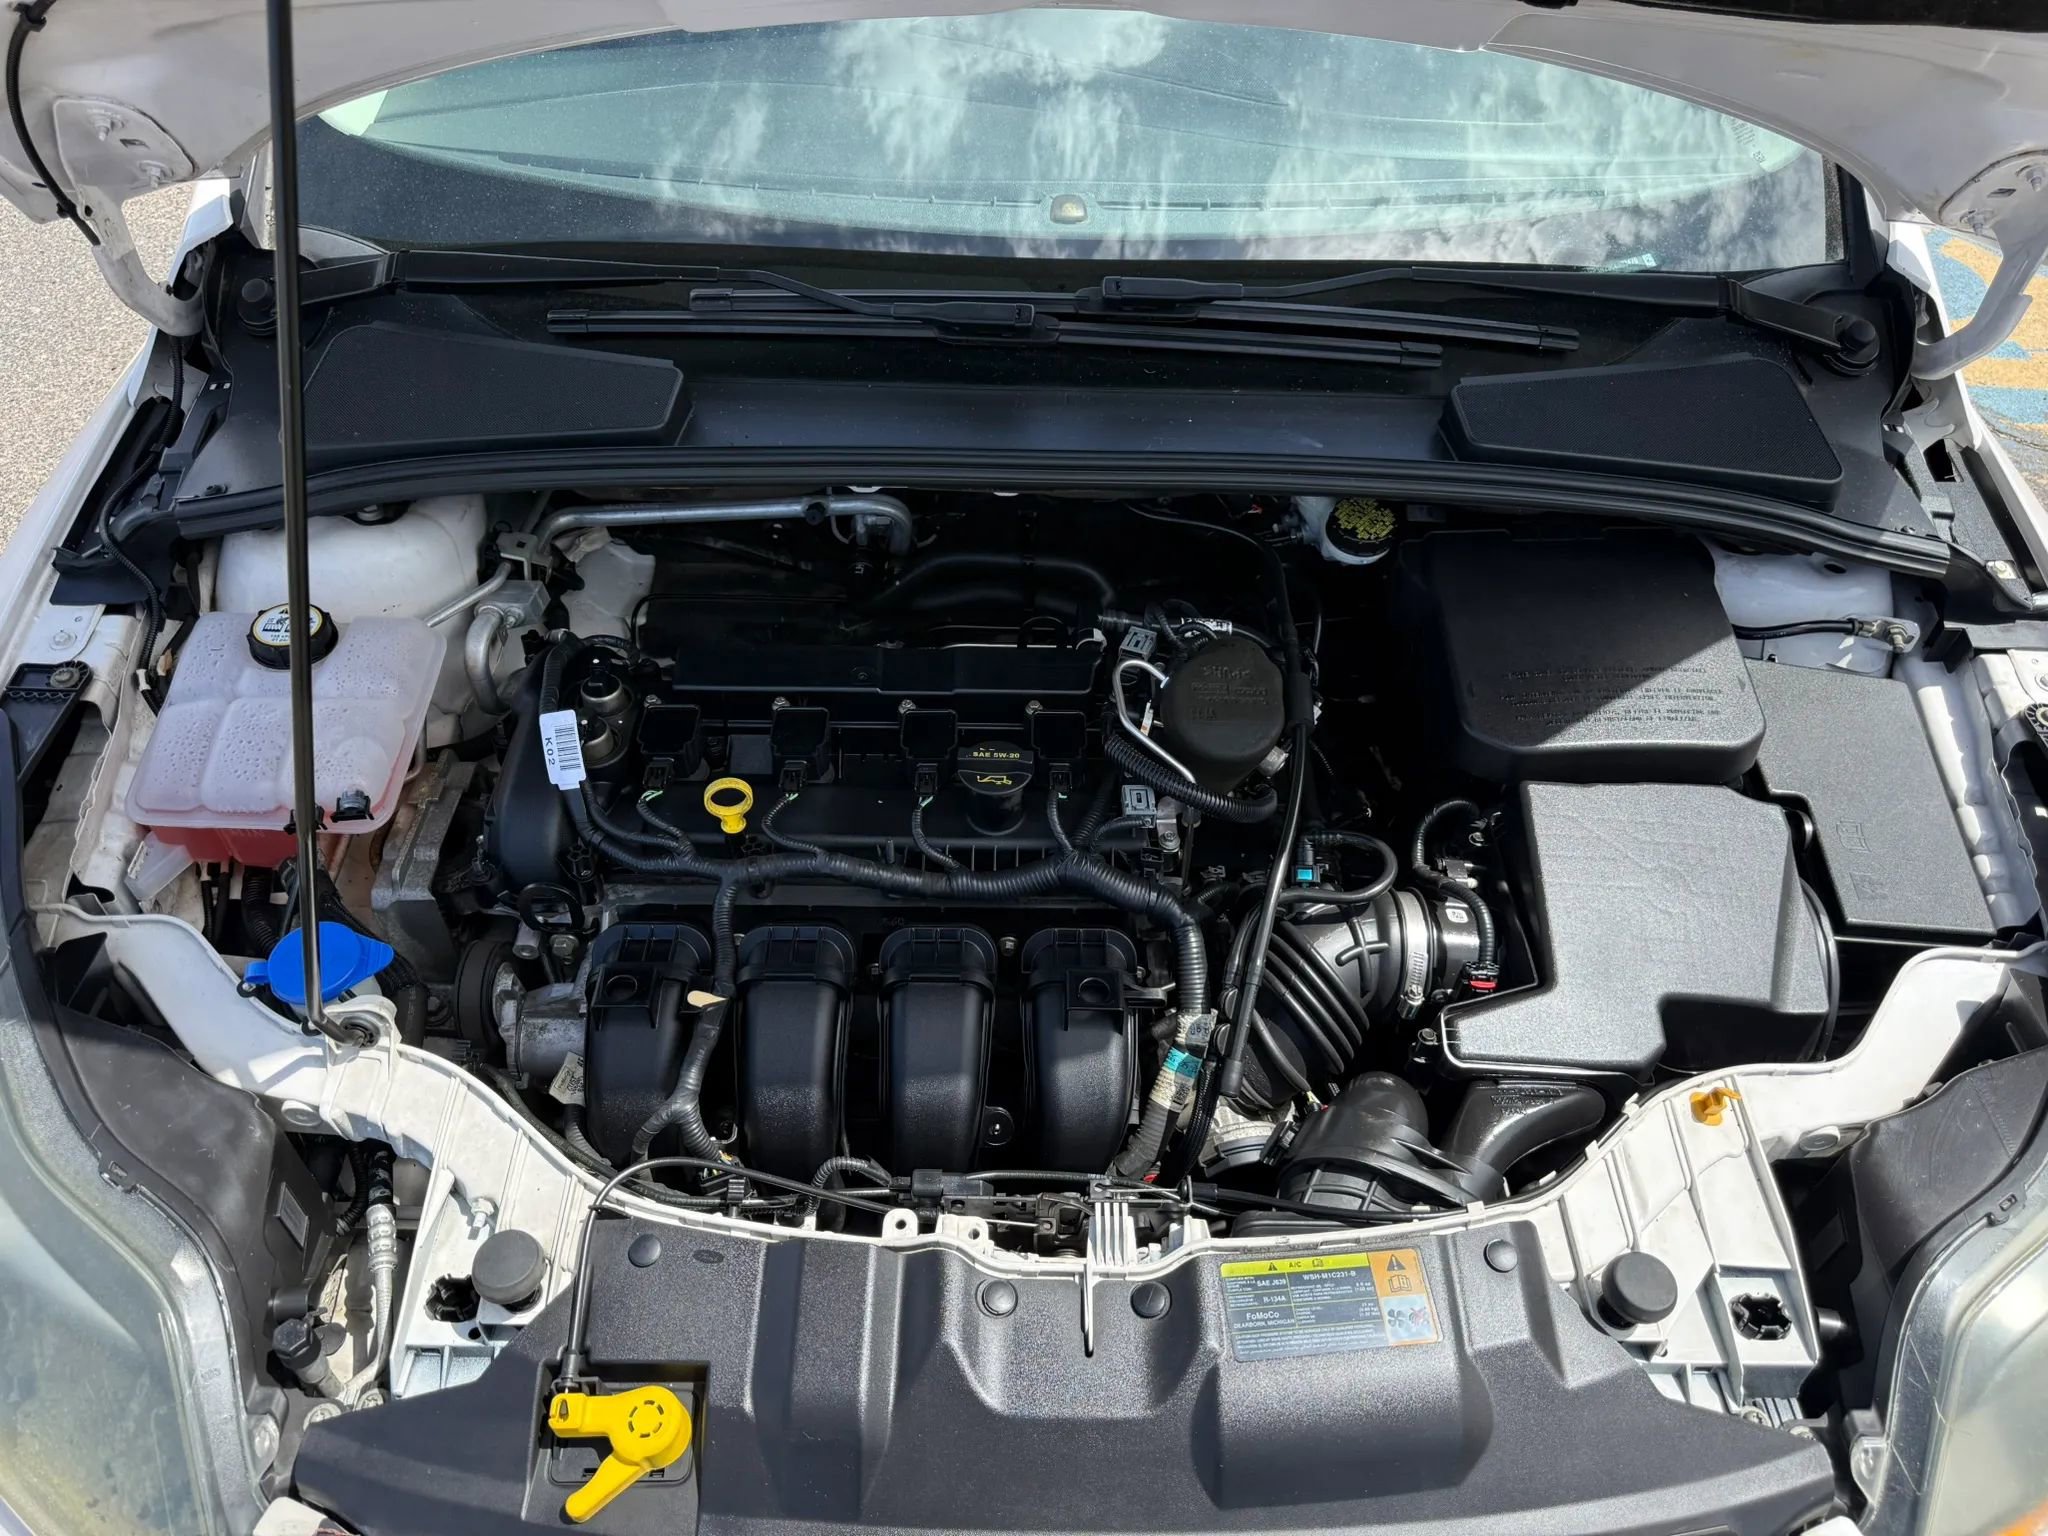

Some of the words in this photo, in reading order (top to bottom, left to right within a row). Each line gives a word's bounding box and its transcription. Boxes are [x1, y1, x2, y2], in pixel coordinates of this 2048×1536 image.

[1257, 1279, 1271, 1287] SAE
[1262, 1295, 1287, 1303] R-134A
[1246, 1311, 1280, 1321] FoMoCo
[1267, 1318, 1296, 1327] MICHIGAN
